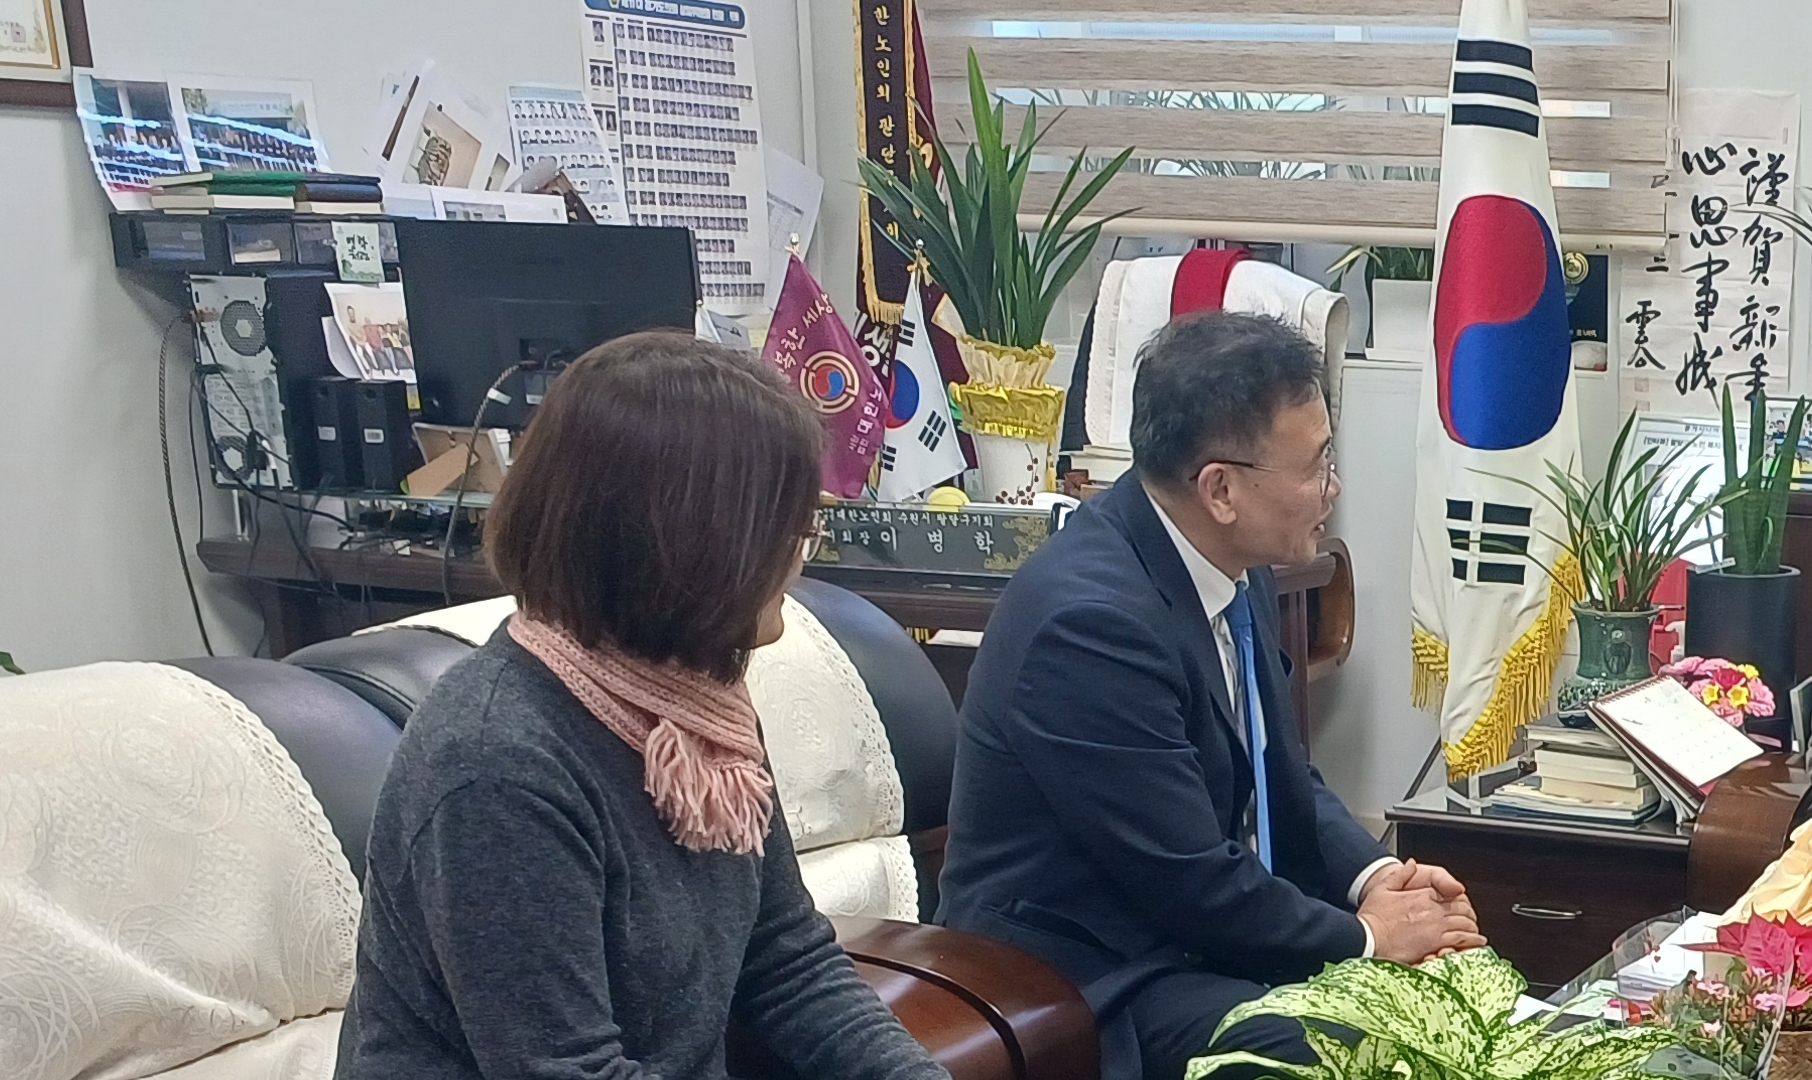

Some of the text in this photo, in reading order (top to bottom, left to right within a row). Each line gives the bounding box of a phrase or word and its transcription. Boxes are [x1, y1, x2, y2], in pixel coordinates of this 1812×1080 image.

[802, 292, 834, 330] 세상
[836, 507, 892, 525] 대한노인회
[898, 511, 931, 526] 수원시
